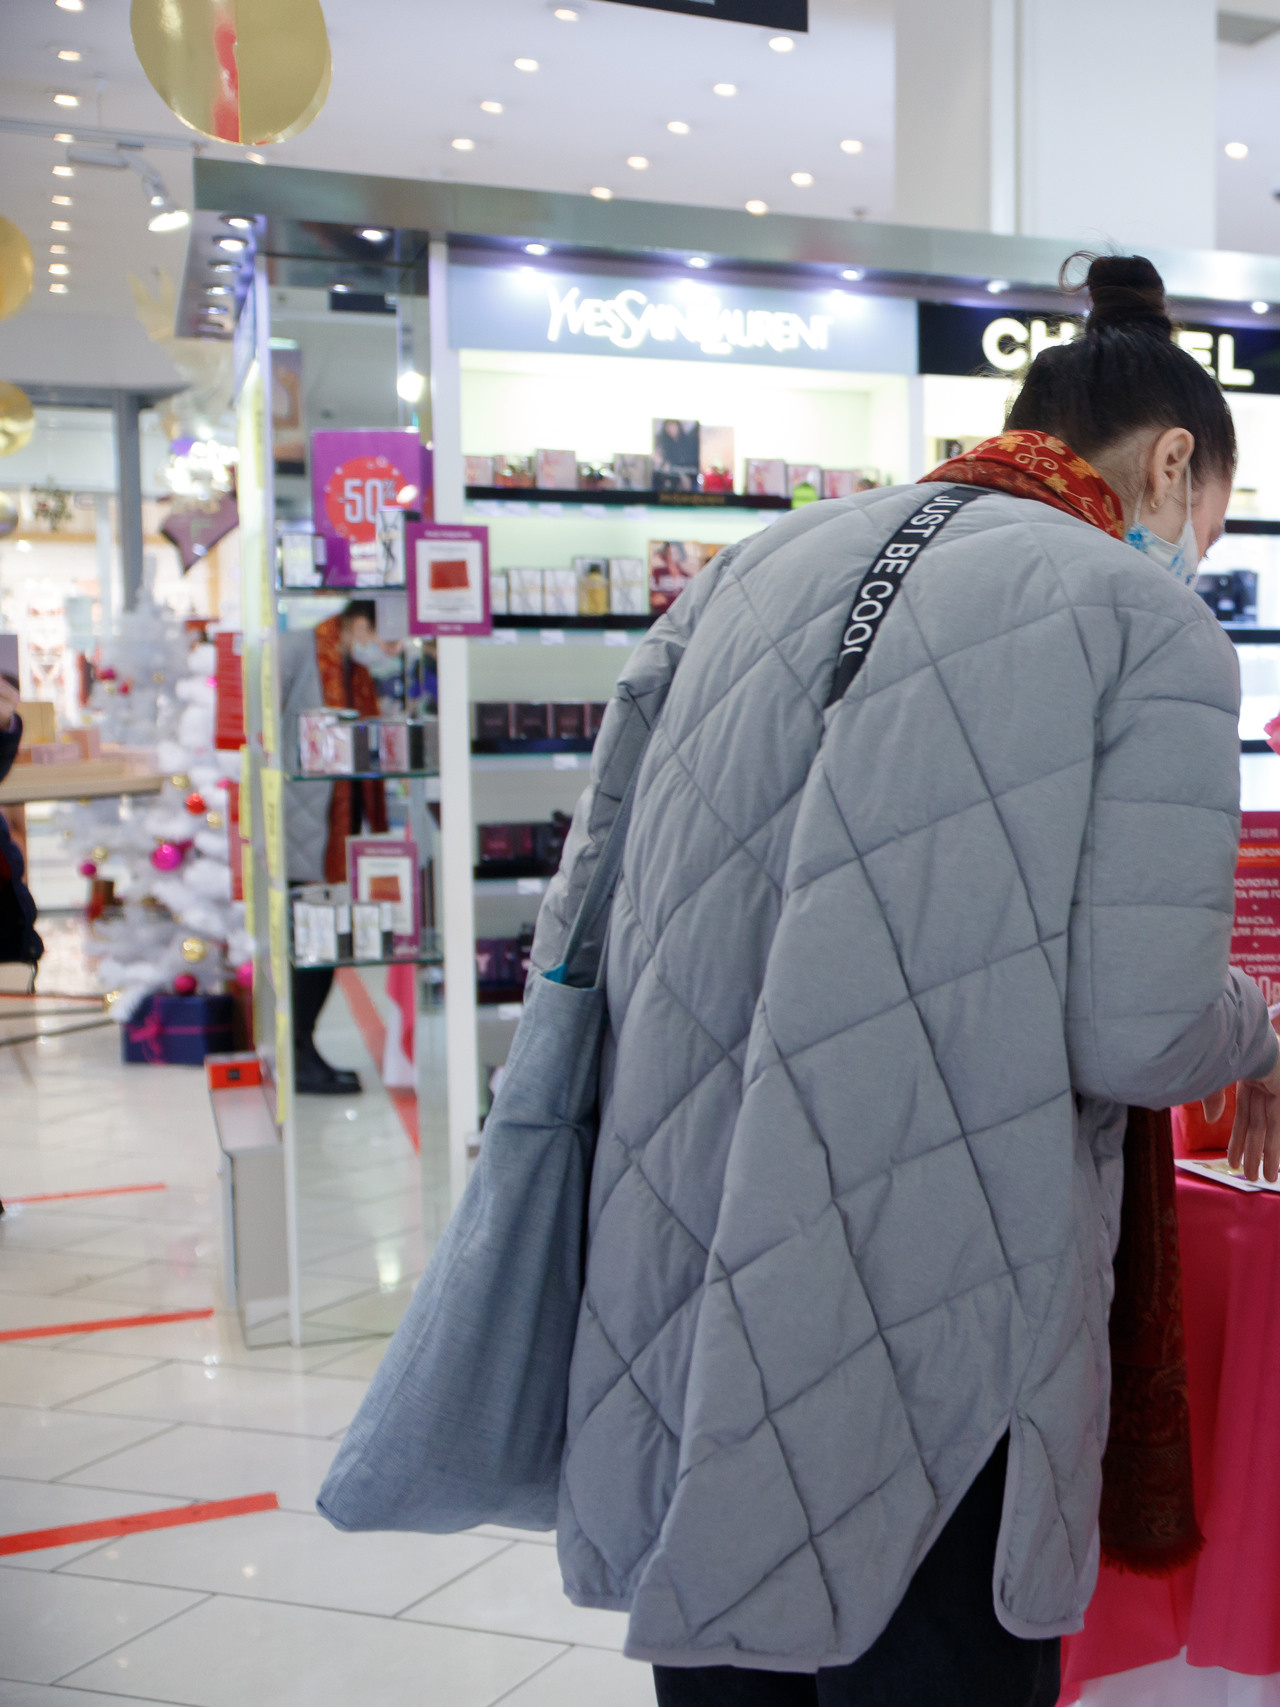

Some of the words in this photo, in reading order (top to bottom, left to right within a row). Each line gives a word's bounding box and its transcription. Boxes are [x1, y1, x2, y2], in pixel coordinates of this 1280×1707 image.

[982, 317, 1255, 386] CHEL
[902, 495, 963, 538] JUST
[873, 543, 920, 574] BE
[1237, 915, 1274, 925] МАСКА
